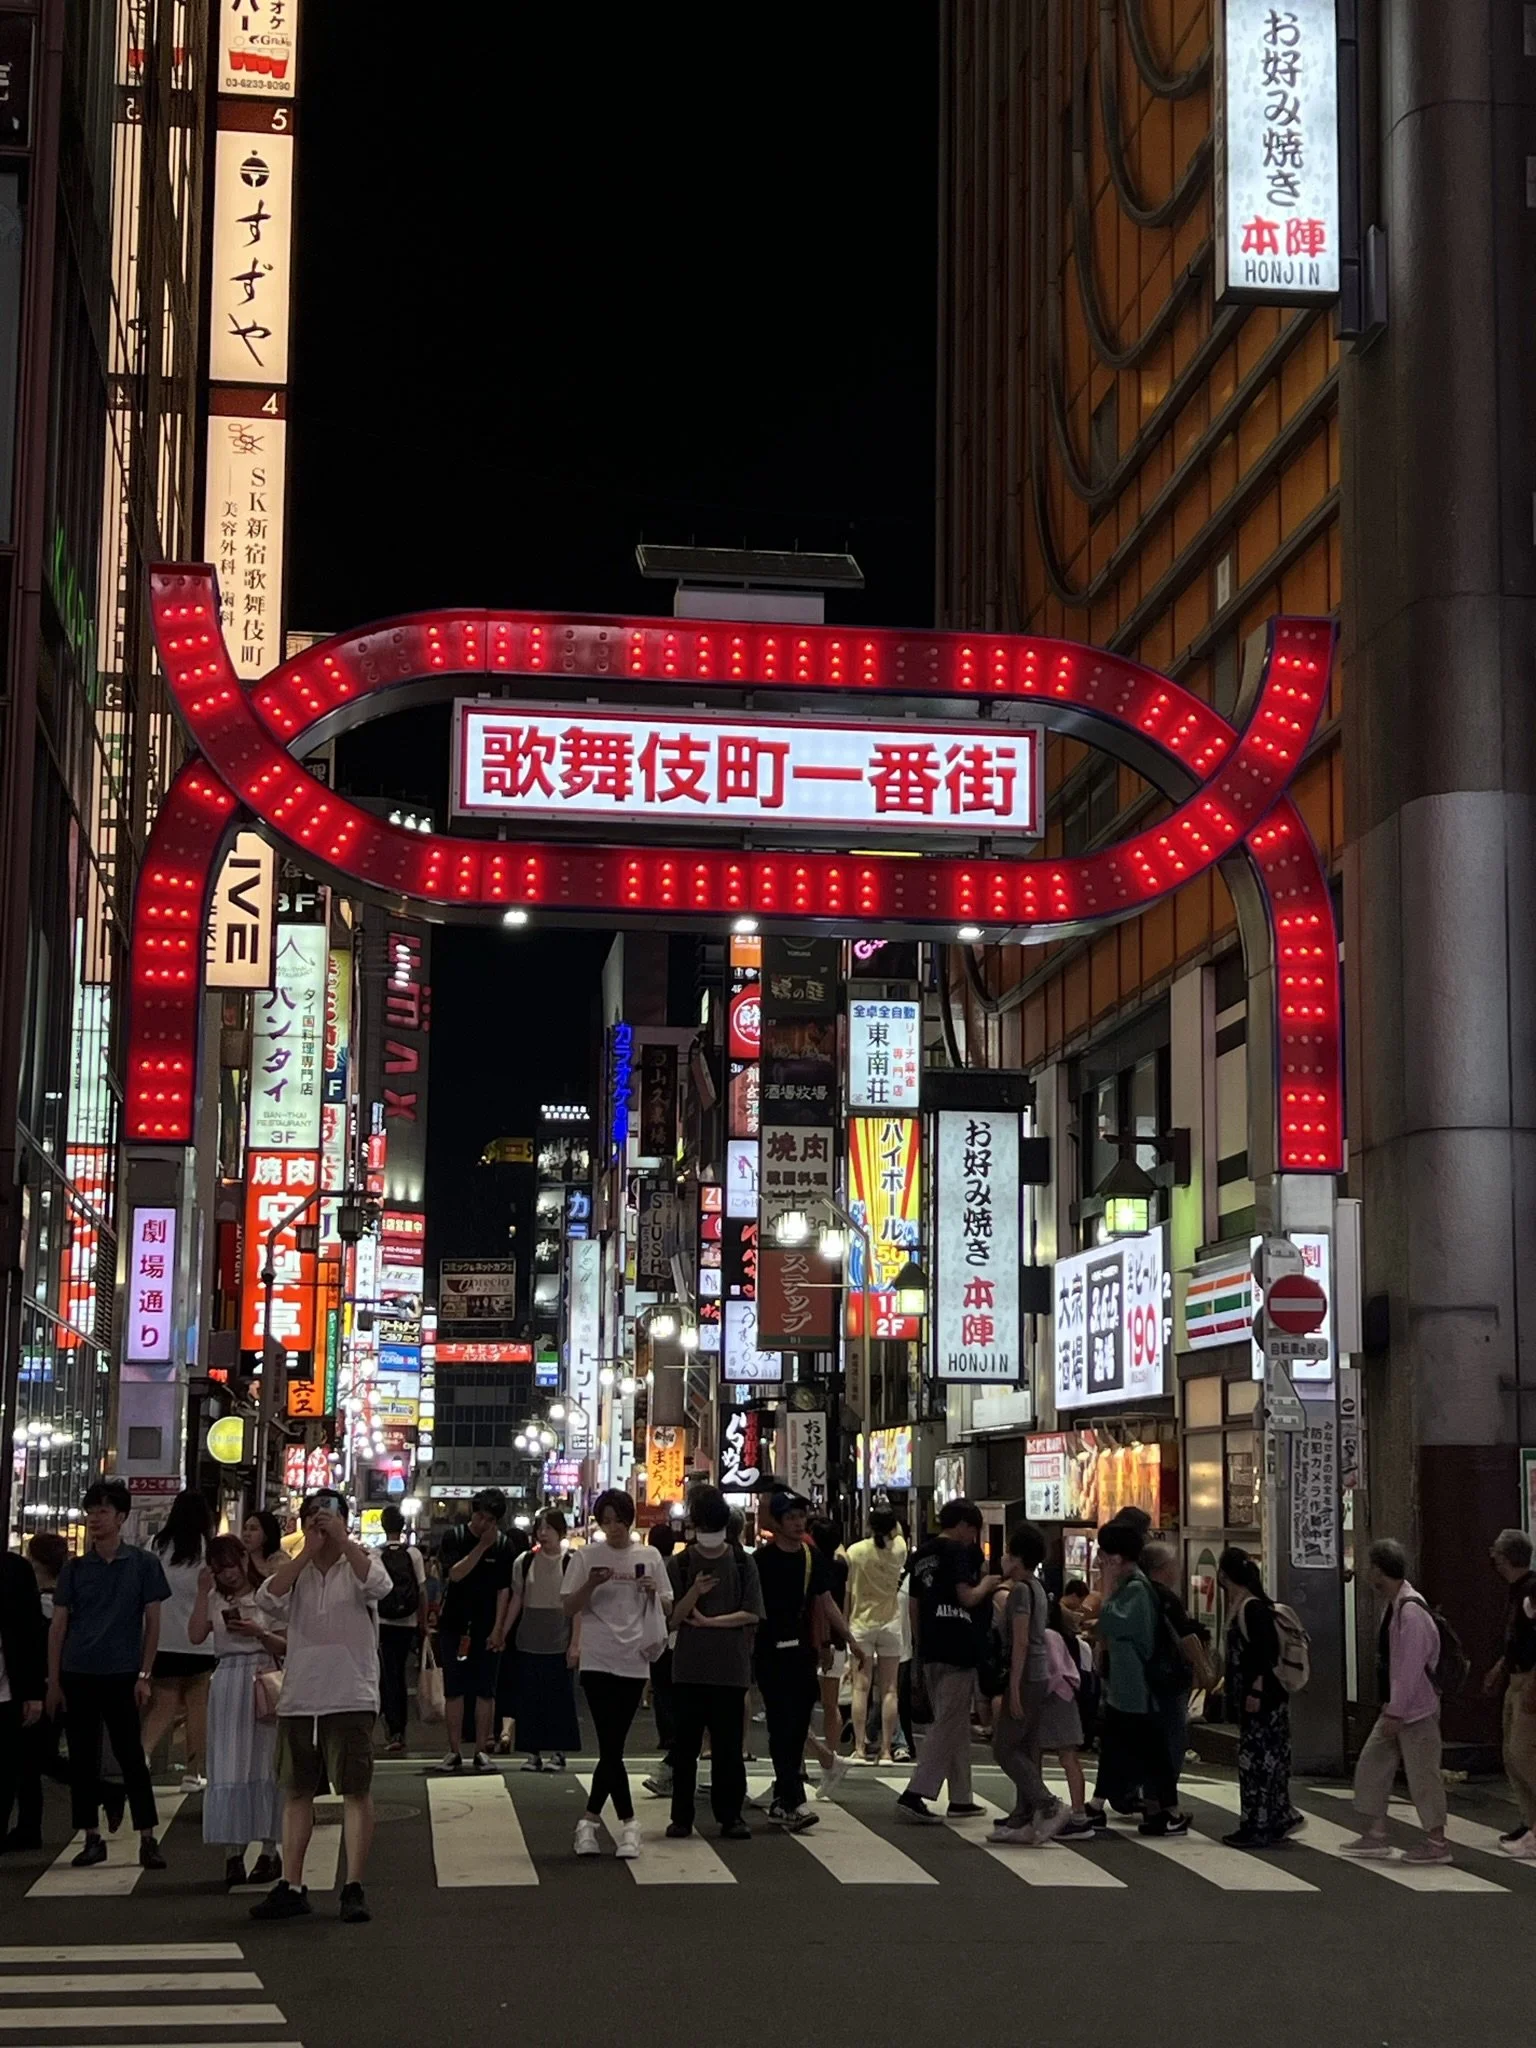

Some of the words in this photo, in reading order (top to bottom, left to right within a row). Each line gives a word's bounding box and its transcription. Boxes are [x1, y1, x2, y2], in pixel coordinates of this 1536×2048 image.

[271, 108, 288, 131] 5
[1261, 9, 1304, 208] お好み焼き
[1240, 214, 1328, 258] 本陣
[228, 199, 275, 368] すずや
[1244, 260, 1320, 286] HONJIN
[262, 392, 279, 415] 4
[241, 467, 269, 666] SK新宿歌舞伎町
[481, 725, 1018, 815] 歌舞伎町一番街
[853, 1004, 916, 1019] 全卓全自動
[866, 1022, 890, 1104] 東南荘
[271, 1131, 297, 1143] 3F
[251, 1156, 316, 1186] 焼肉
[880, 1122, 905, 1241] ハイボール
[963, 1119, 993, 1267] お好み焼き
[651, 1194, 662, 1273] SLUSH
[138, 1219, 167, 1348] 劇場通り
[876, 1319, 905, 1337] 2F
[963, 1276, 994, 1348] 本陣
[1127, 1303, 1156, 1368] 190
[446, 1343, 528, 1354] ゴールドラッシュ
[948, 1353, 1009, 1374] HONJIN
[1270, 1343, 1324, 1356] 自転車を除く
